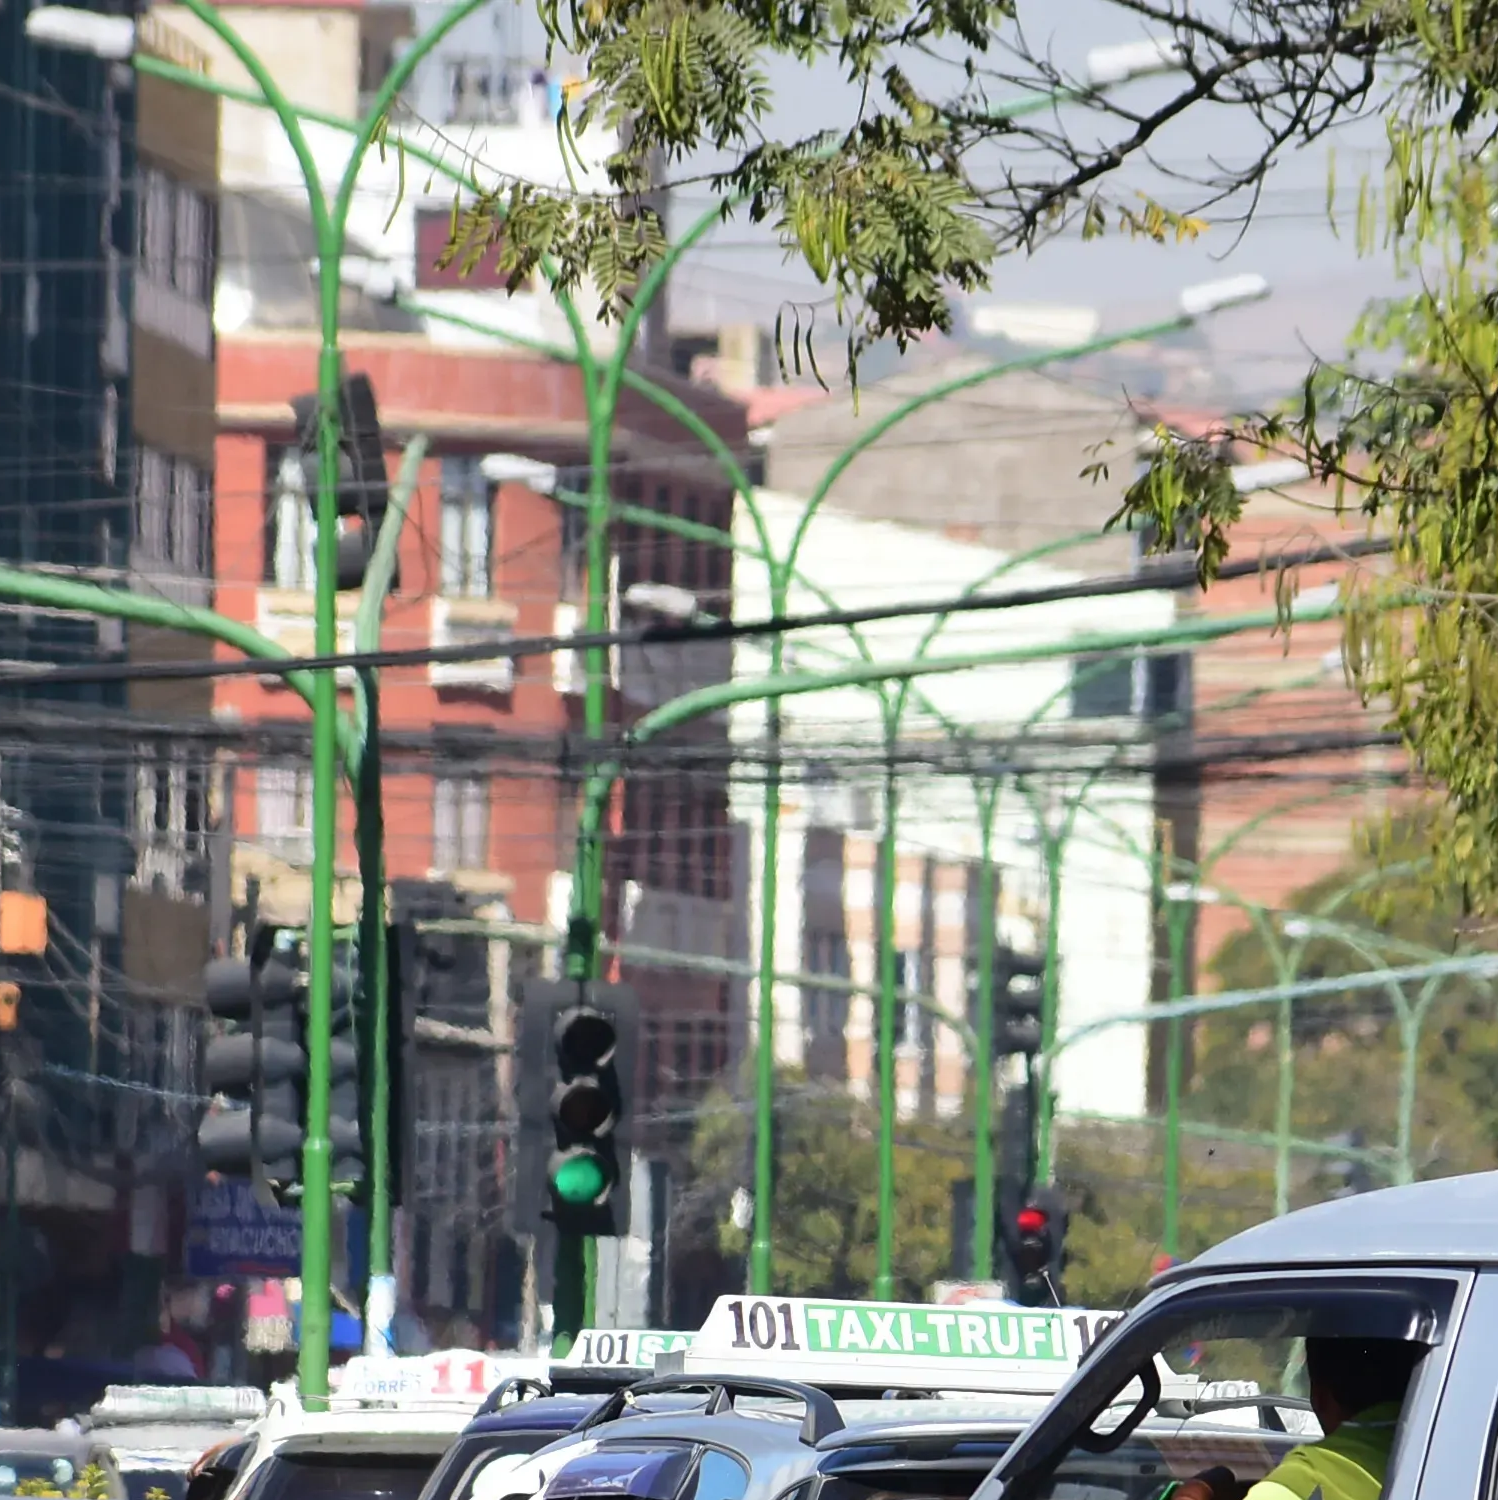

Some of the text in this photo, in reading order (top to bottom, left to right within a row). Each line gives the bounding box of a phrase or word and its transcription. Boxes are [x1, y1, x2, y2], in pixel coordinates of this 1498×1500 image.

[728, 1301, 801, 1351] 101
[808, 1308, 1065, 1357] TAXI-TRUFI
[581, 1333, 629, 1365] 101
[430, 1357, 488, 1394] 11
